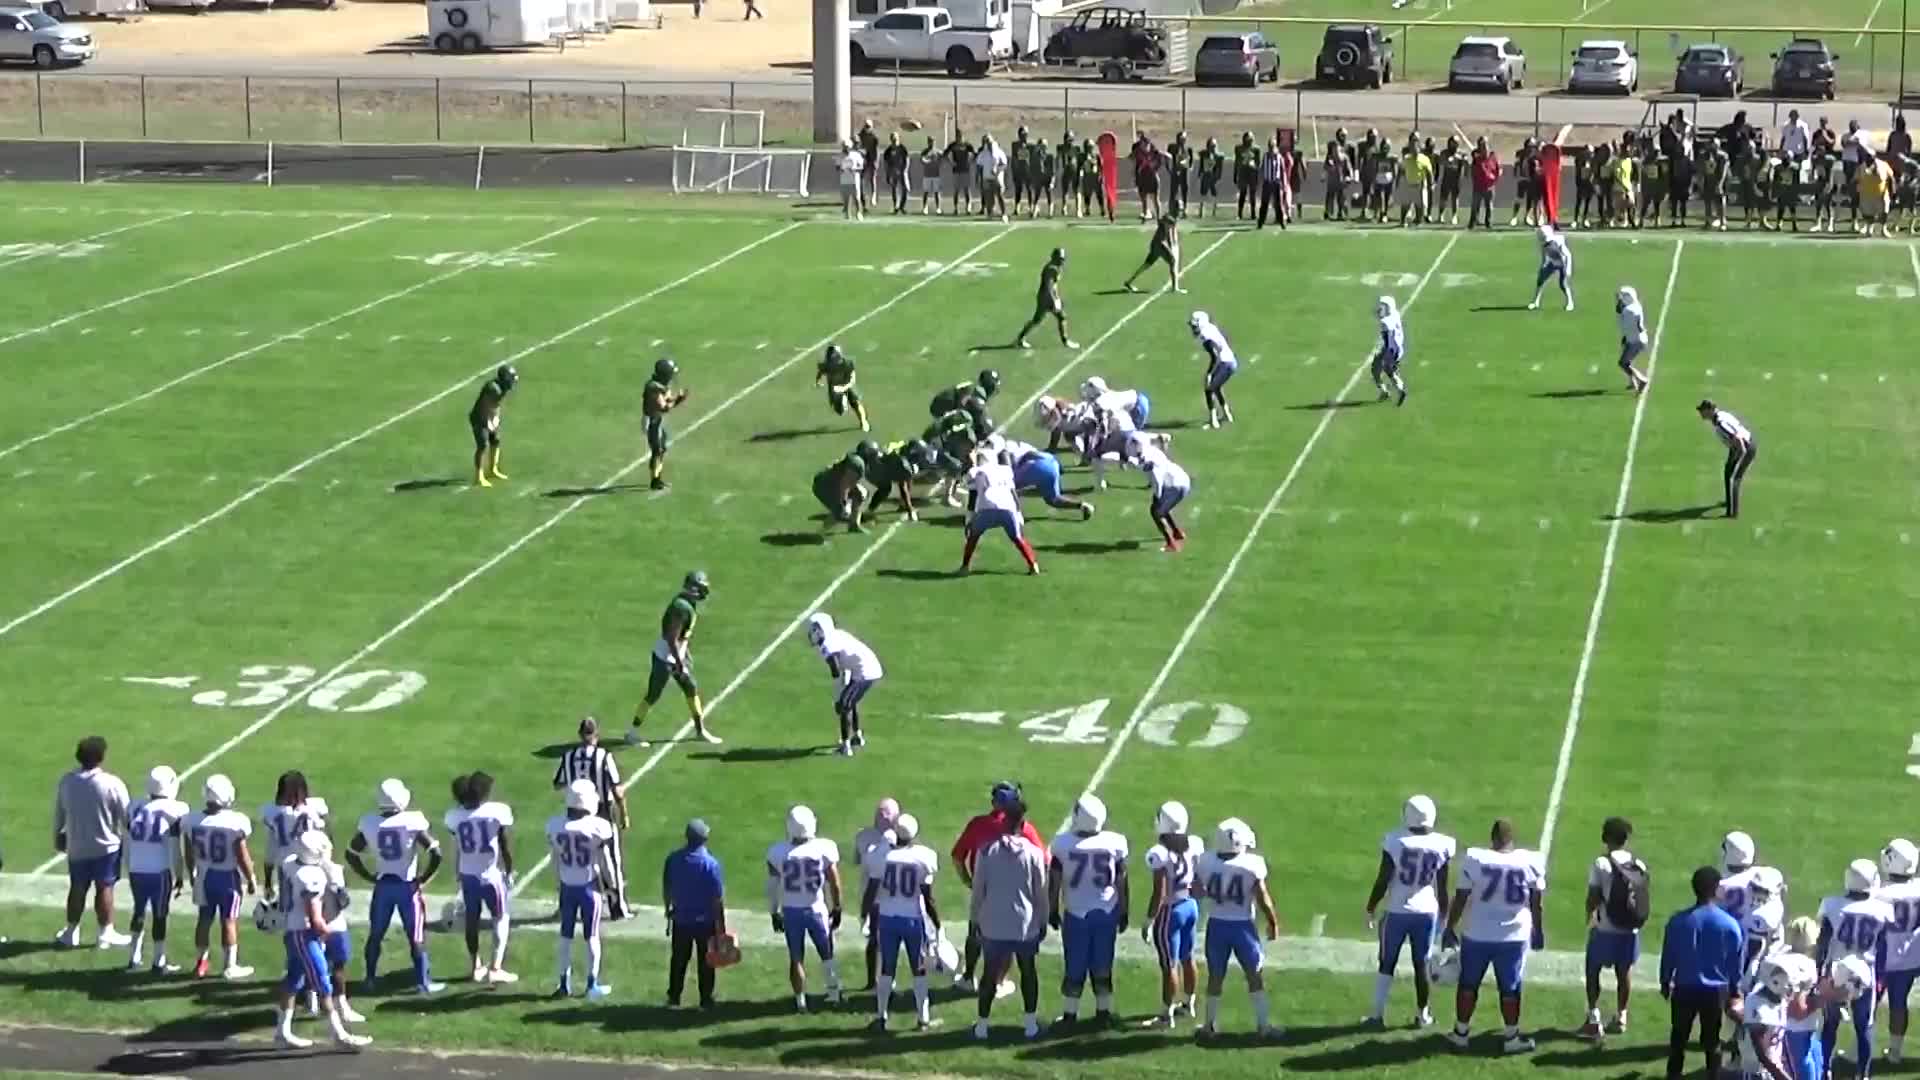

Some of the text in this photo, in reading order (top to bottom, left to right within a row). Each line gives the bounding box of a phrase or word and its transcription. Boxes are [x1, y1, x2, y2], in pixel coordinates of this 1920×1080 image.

[192, 664, 428, 712] 30
[1018, 698, 1249, 746] 40
[378, 830, 402, 860] 9
[458, 820, 494, 853] 81
[556, 834, 592, 867] 35
[783, 858, 821, 892] 25
[883, 863, 917, 897] 40
[1069, 851, 1112, 888] 75
[1481, 866, 1526, 904] 76
[1207, 872, 1244, 905] 44
[1838, 913, 1876, 949] 46
